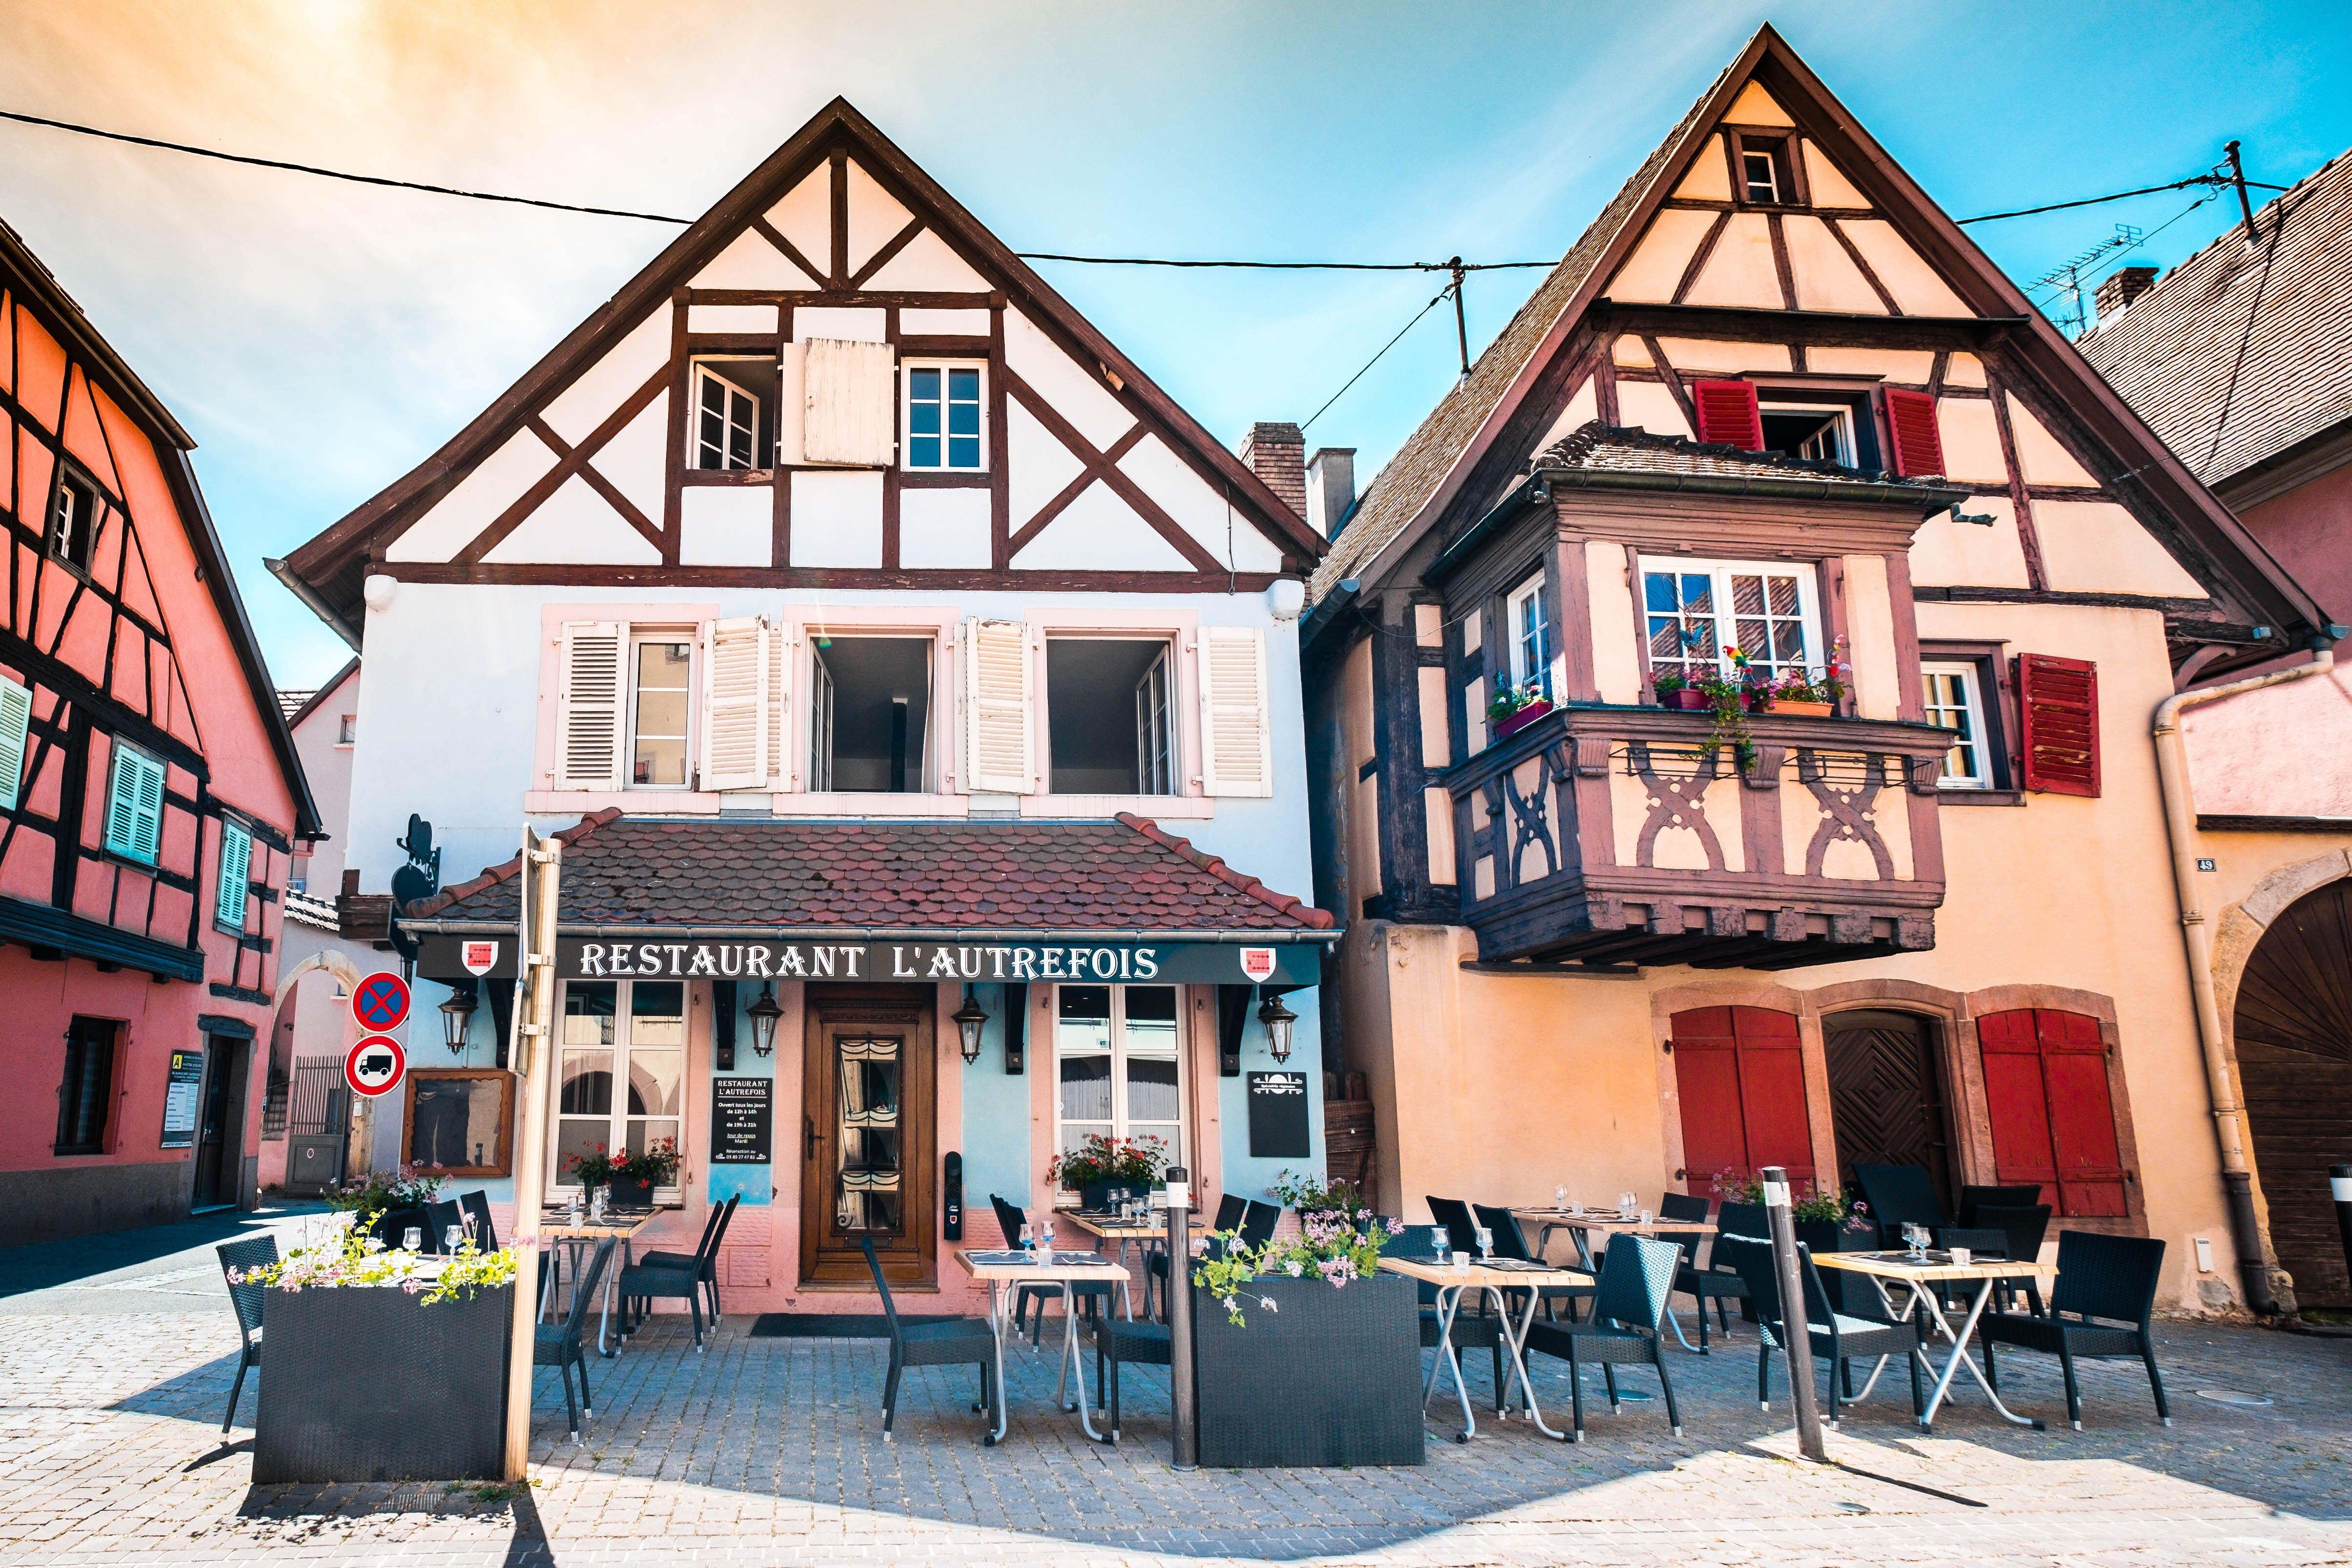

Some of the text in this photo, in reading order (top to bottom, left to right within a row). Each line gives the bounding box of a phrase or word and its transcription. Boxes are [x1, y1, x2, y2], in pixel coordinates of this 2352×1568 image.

[2200, 860, 2212, 869] 49
[580, 944, 1158, 979] RESTAURANT L'AUTREFOIS
[173, 1058, 180, 1068] A
